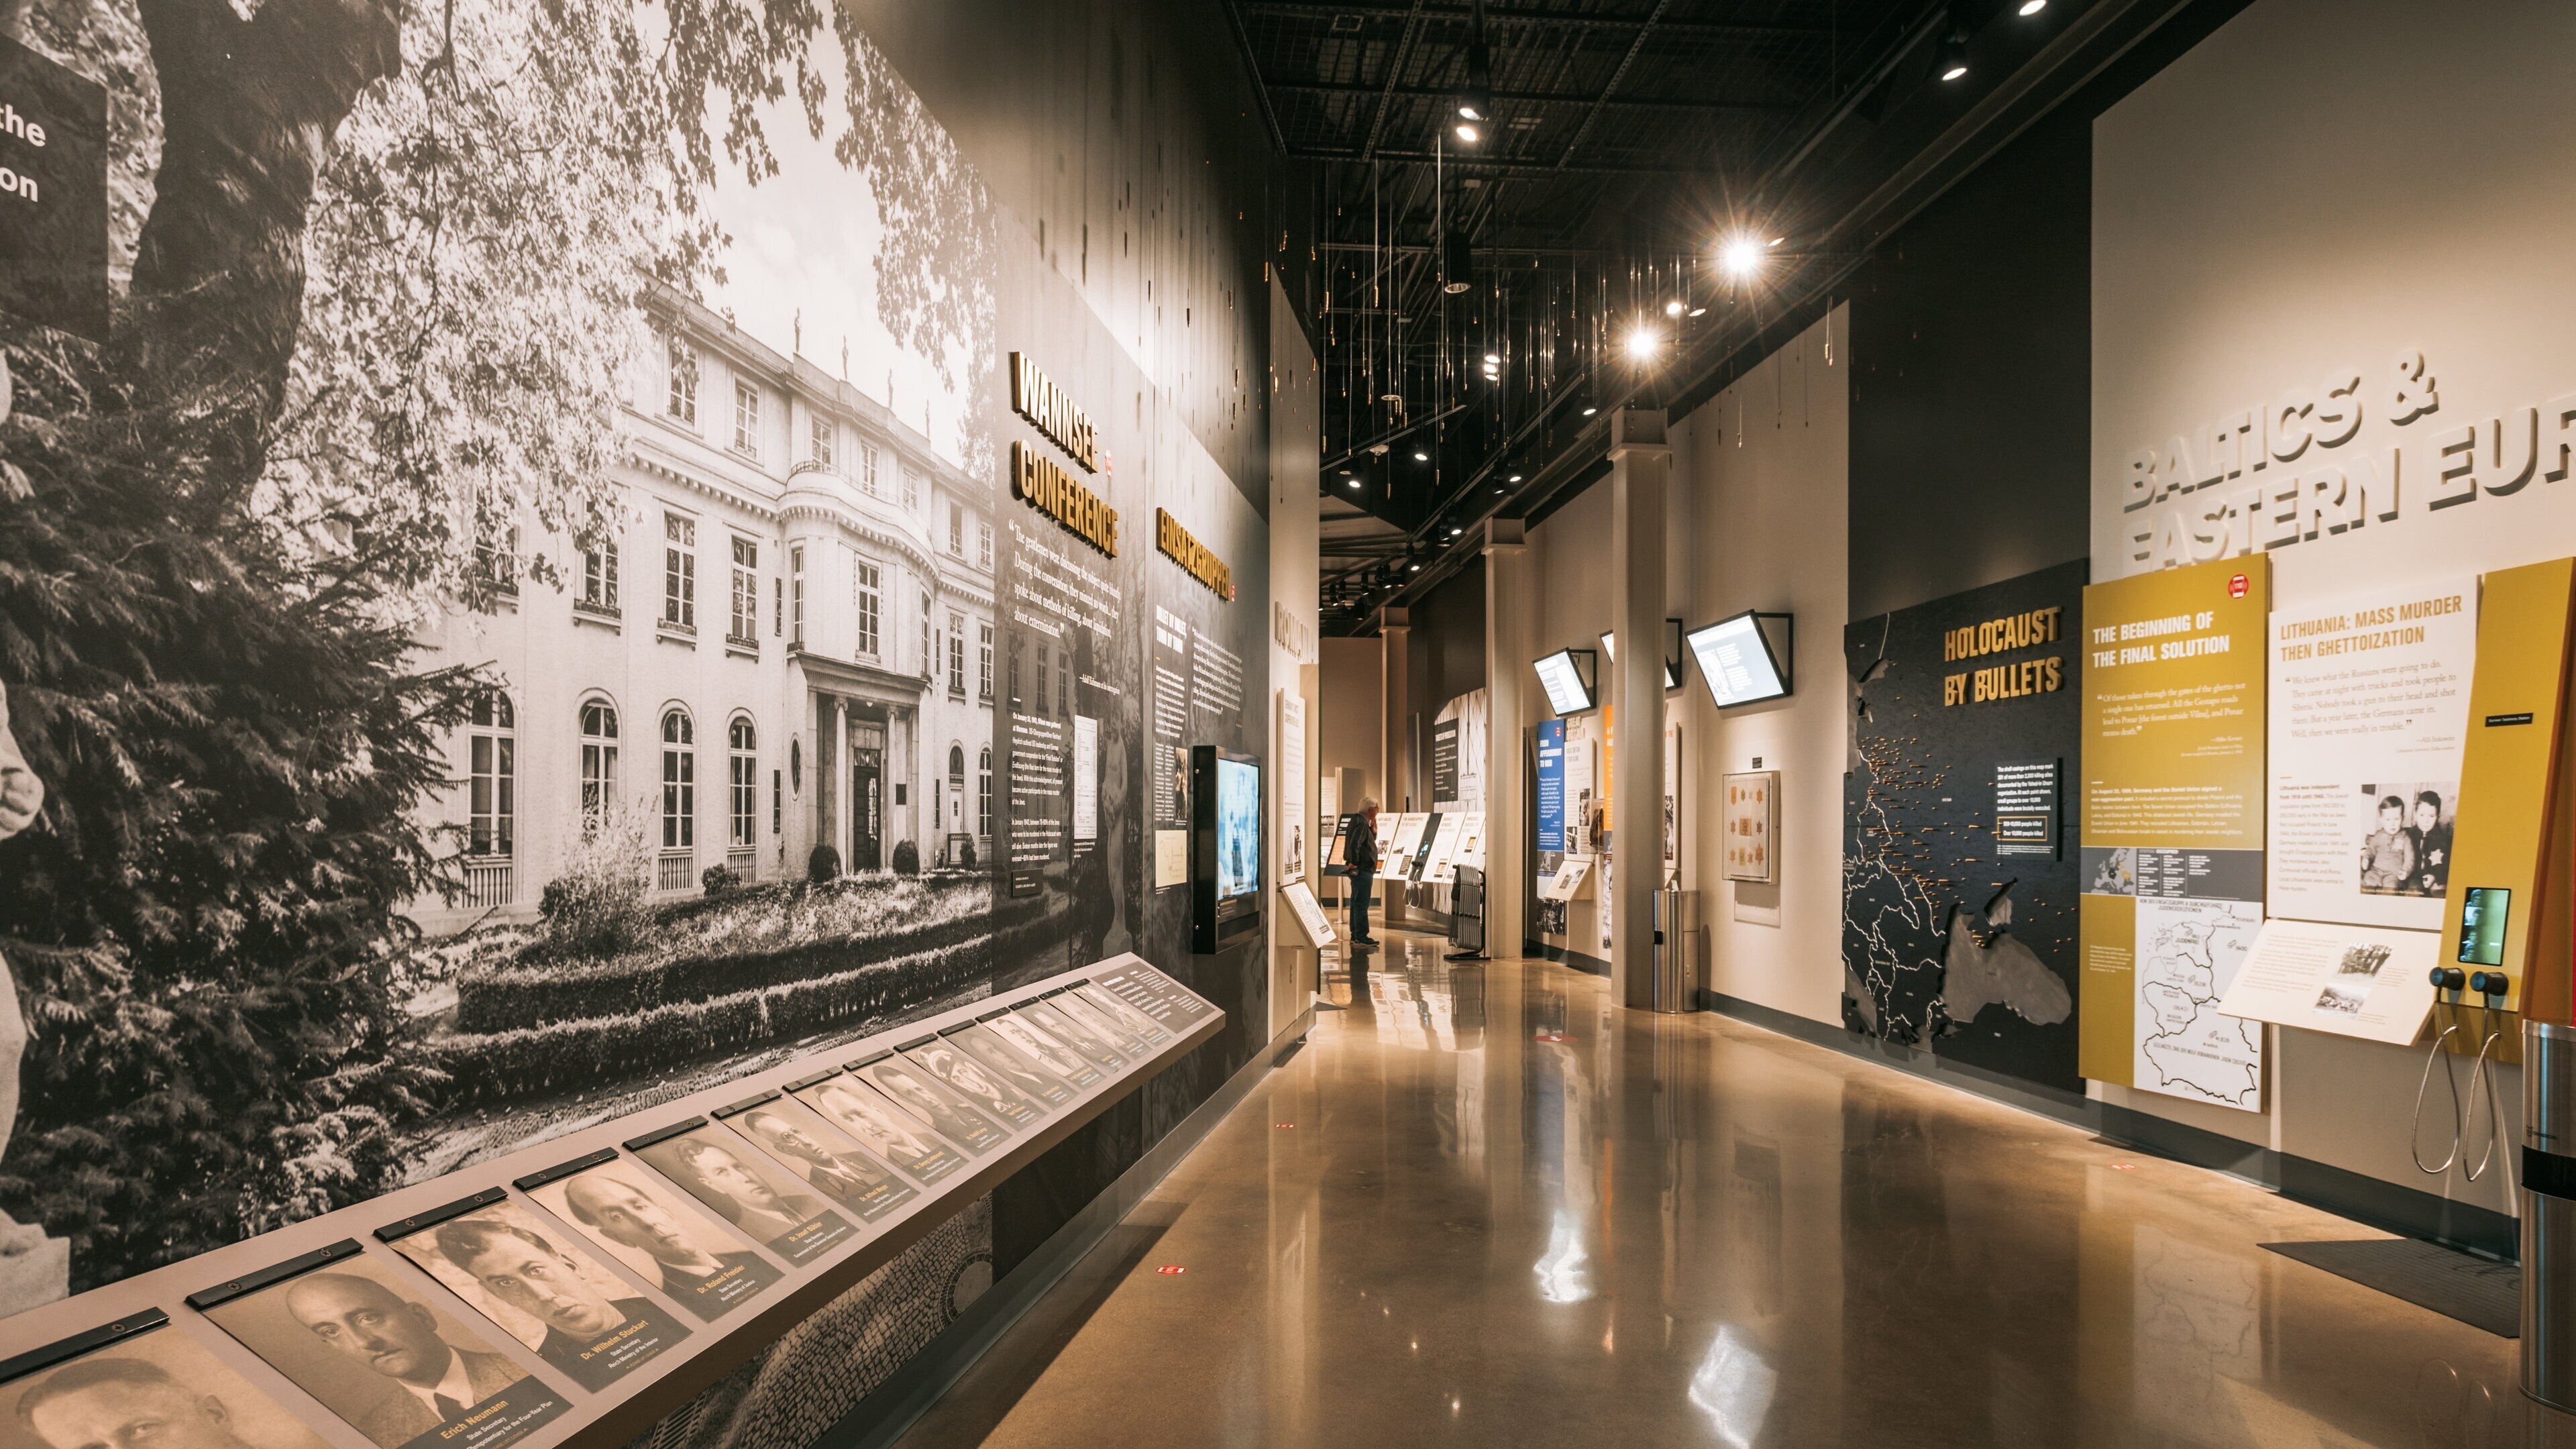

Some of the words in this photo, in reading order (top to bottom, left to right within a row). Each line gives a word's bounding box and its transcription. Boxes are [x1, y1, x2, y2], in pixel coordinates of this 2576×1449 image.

[1013, 351, 1099, 474] WANNSEE
[2123, 368, 2361, 513] BALTICS
[2388, 348, 2439, 427] &
[1014, 439, 1118, 559] CONFERENCE
[2122, 447, 2400, 575] EASTERN
[1157, 507, 1230, 601] EINSATZGRUPPEN
[1945, 606, 2063, 662] HOLOCAUST
[2093, 625, 2116, 644] THE
[2121, 614, 2191, 641] BEGINNING
[2196, 610, 2213, 630] OF
[2280, 615, 2351, 641] LITHUANIA:
[2355, 606, 2394, 629] MASS
[2399, 594, 2462, 621] MURDER
[2093, 650, 2116, 668] THE
[2120, 643, 2156, 665] FINAL
[2161, 635, 2229, 660] SOLUTION
[2281, 643, 2312, 661] THEN
[2317, 625, 2425, 657] GHETTOIZATION
[1945, 673, 1968, 706] BY
[1975, 656, 2063, 703] BULLETS
[705, 1275, 727, 1288] Roland
[723, 1265, 745, 1278] Freisler
[580, 1352, 594, 1360] Dr.
[590, 1336, 622, 1353] Wilhelm
[619, 1320, 649, 1338] Stuckart
[610, 1348, 623, 1356] State
[620, 1338, 641, 1350] Secretary
[439, 1422, 468, 1440] Erich
[464, 1400, 509, 1426] Neumann
[466, 1430, 483, 1440] State
[480, 1416, 507, 1432] Secretary
[502, 1424, 512, 1432] for
[518, 1408, 542, 1421] Four-Year
[540, 1400, 553, 1409] Plan
